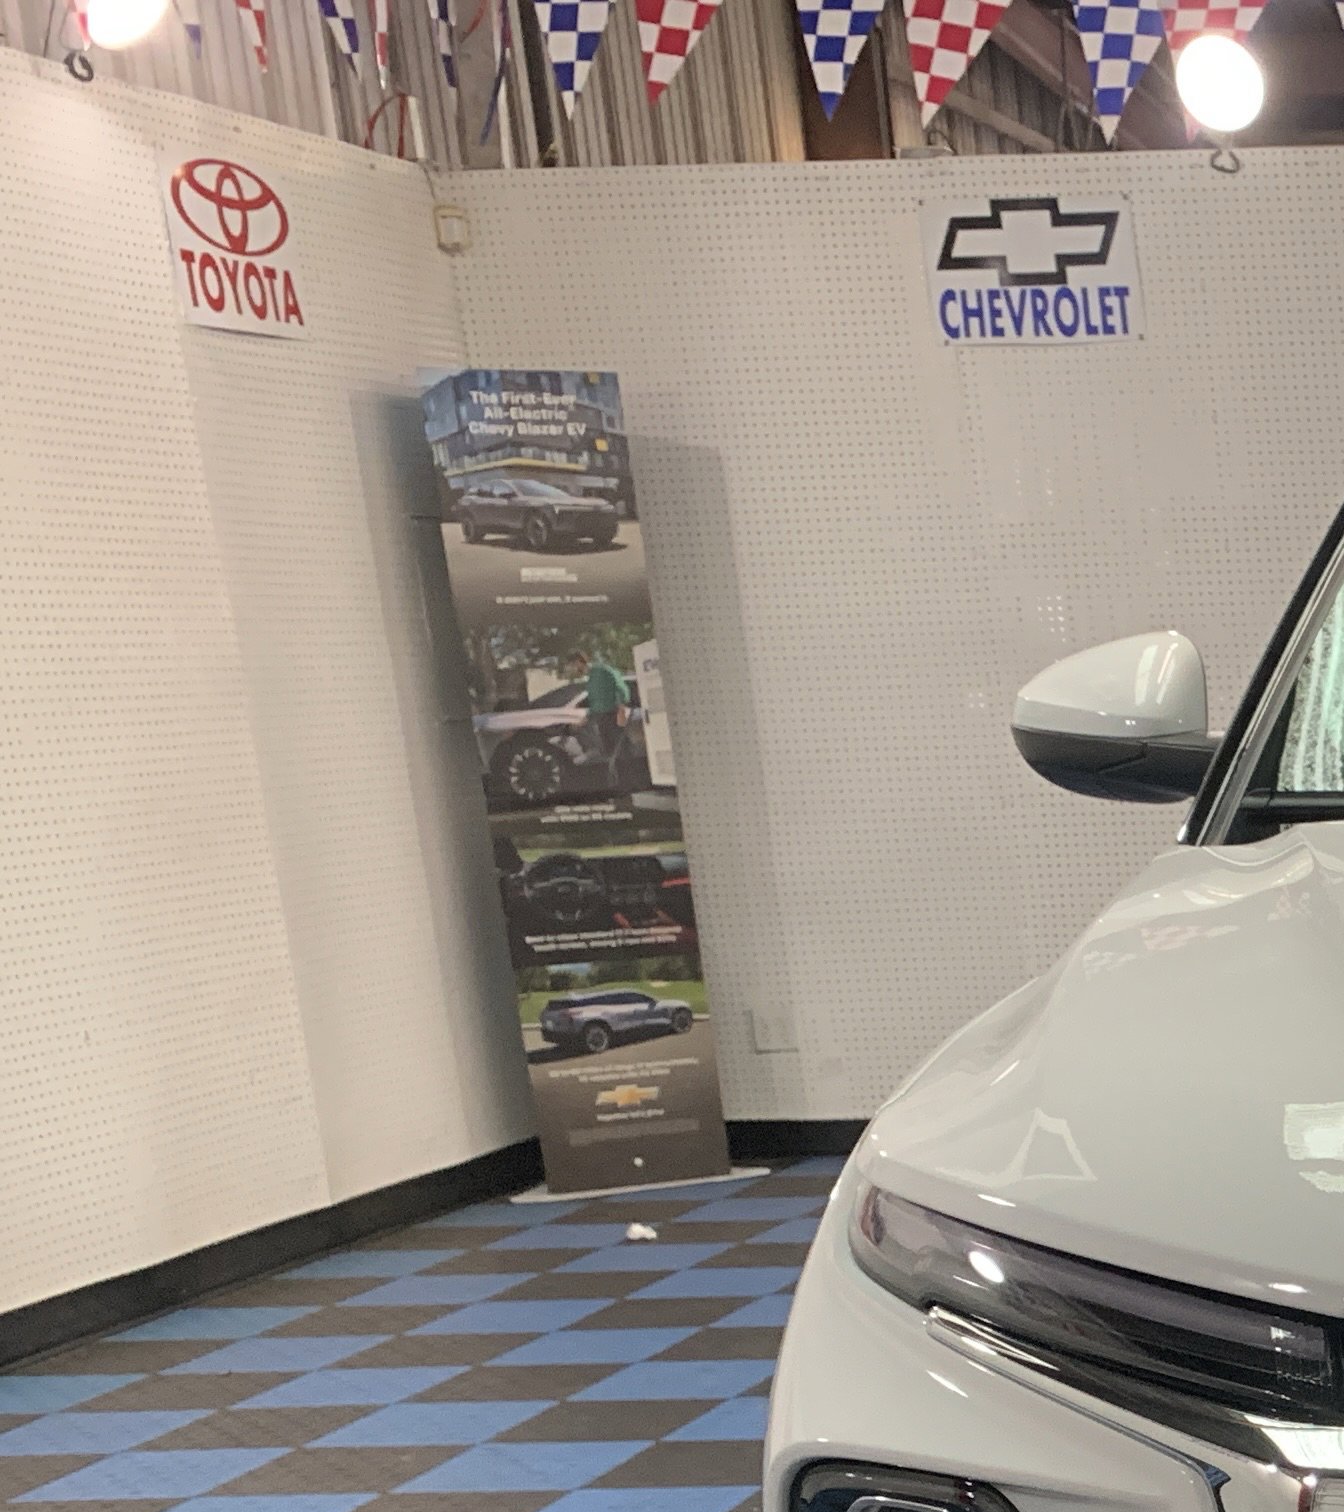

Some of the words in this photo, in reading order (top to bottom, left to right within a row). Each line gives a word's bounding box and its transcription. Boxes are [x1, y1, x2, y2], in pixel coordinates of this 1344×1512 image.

[179, 248, 305, 327] TOYOTA
[939, 286, 1130, 339] CHEVROLET
[469, 390, 498, 405] The
[566, 422, 587, 436] EV
